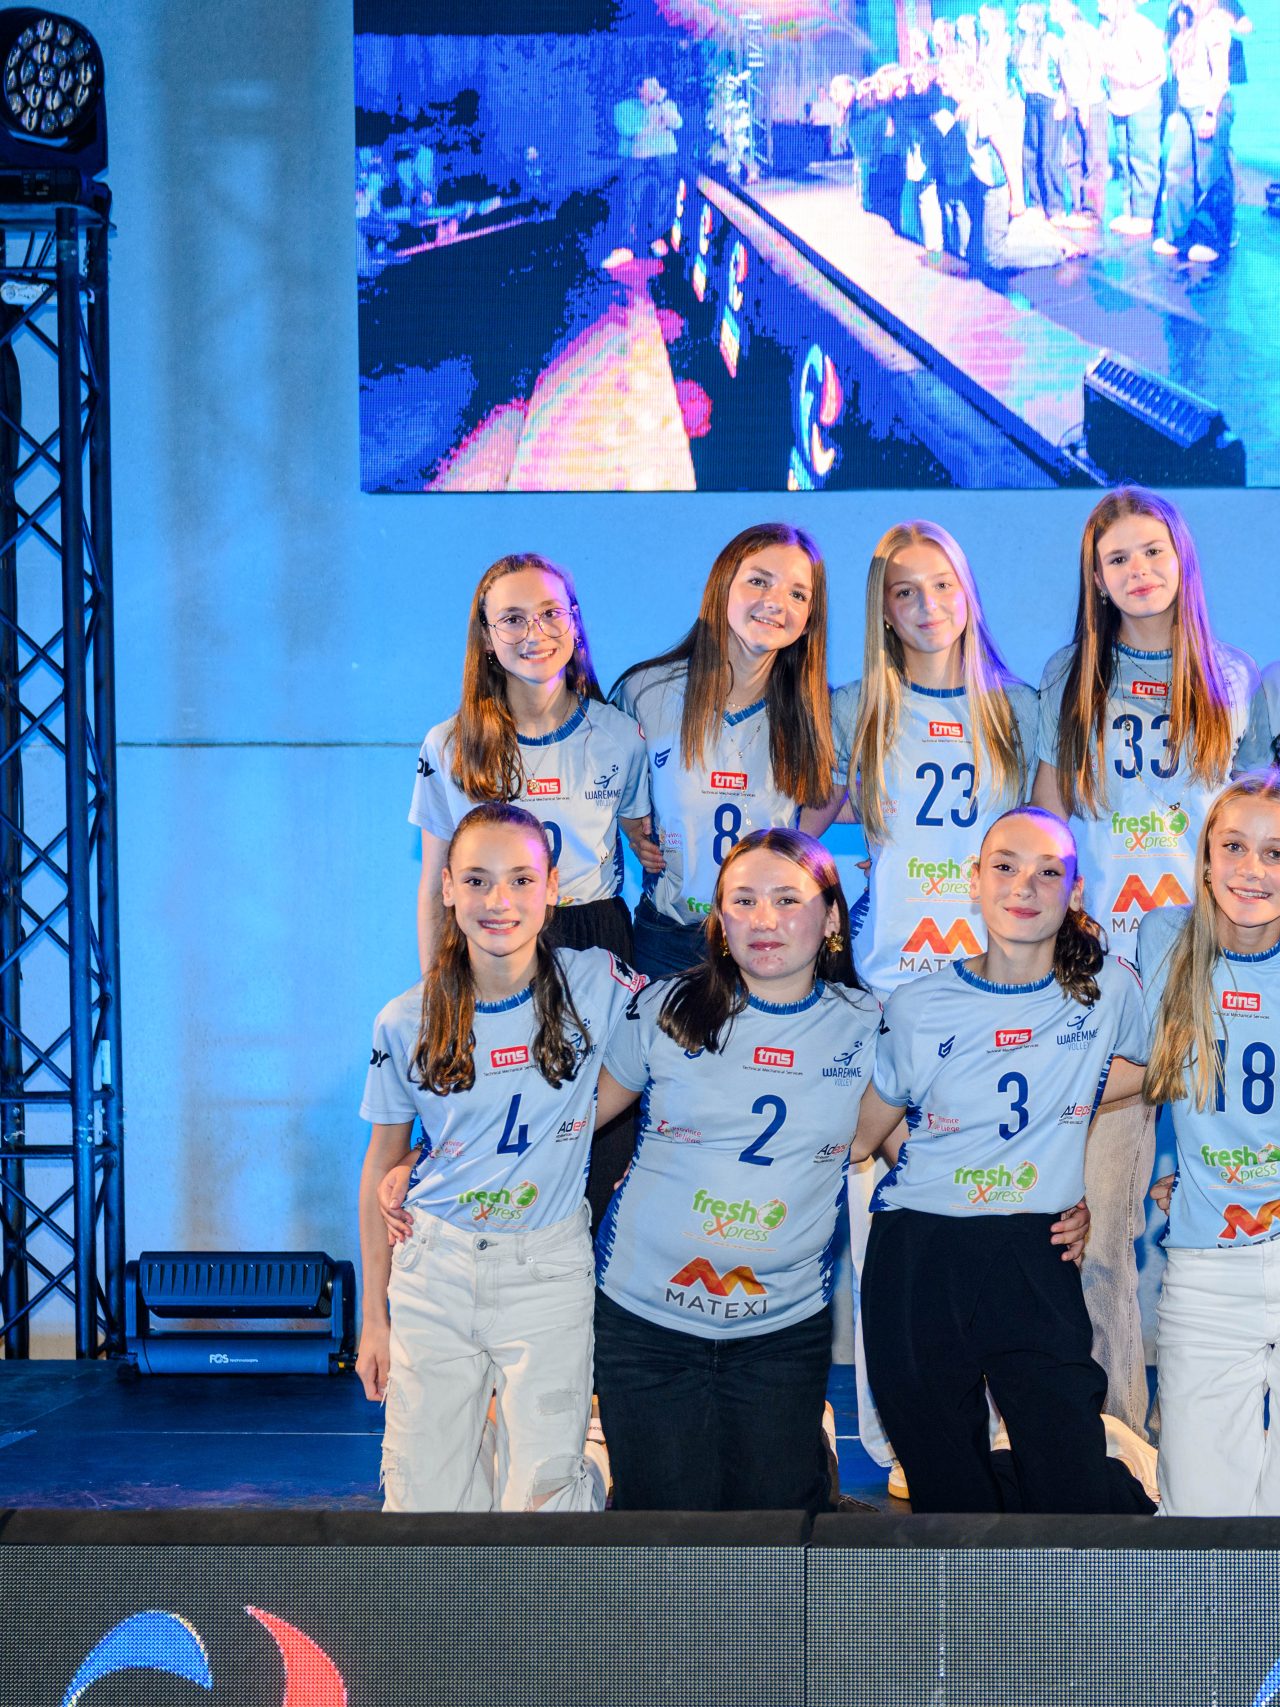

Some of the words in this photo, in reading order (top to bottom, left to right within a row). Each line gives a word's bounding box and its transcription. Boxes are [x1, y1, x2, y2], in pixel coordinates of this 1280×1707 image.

[1135, 683, 1165, 694] tms
[932, 723, 961, 735] tms
[1112, 714, 1179, 778] 33
[714, 774, 745, 787] tms
[916, 762, 978, 827] 23
[1112, 811, 1164, 834] fresh
[713, 803, 742, 867] 8
[1125, 831, 1178, 852] eXpress
[908, 857, 961, 879] fresh
[921, 877, 972, 896] eXpres
[687, 897, 713, 914] fre
[899, 957, 957, 973] MAT
[1226, 993, 1258, 1009] tms
[998, 1032, 1029, 1045] tms
[1057, 1028, 1099, 1046] WAREMME
[493, 1049, 526, 1065] tms
[758, 1048, 792, 1065] tms
[822, 1067, 862, 1078] WAREMME
[1215, 1039, 1276, 1115] 18
[997, 1071, 1029, 1141] 3
[497, 1093, 534, 1158] 4
[557, 1119, 587, 1135] Adep
[738, 1094, 787, 1167] 2
[1201, 1145, 1258, 1167] fresh
[954, 1165, 1012, 1187] fresh
[1220, 1163, 1277, 1184] eXpress
[967, 1184, 1024, 1204] eXpress
[472, 1203, 523, 1221] eXpress
[692, 1189, 758, 1224] fresh
[703, 1216, 769, 1242] eXpress
[665, 1287, 768, 1319] MATEXI
[210, 1353, 229, 1364] FOS
